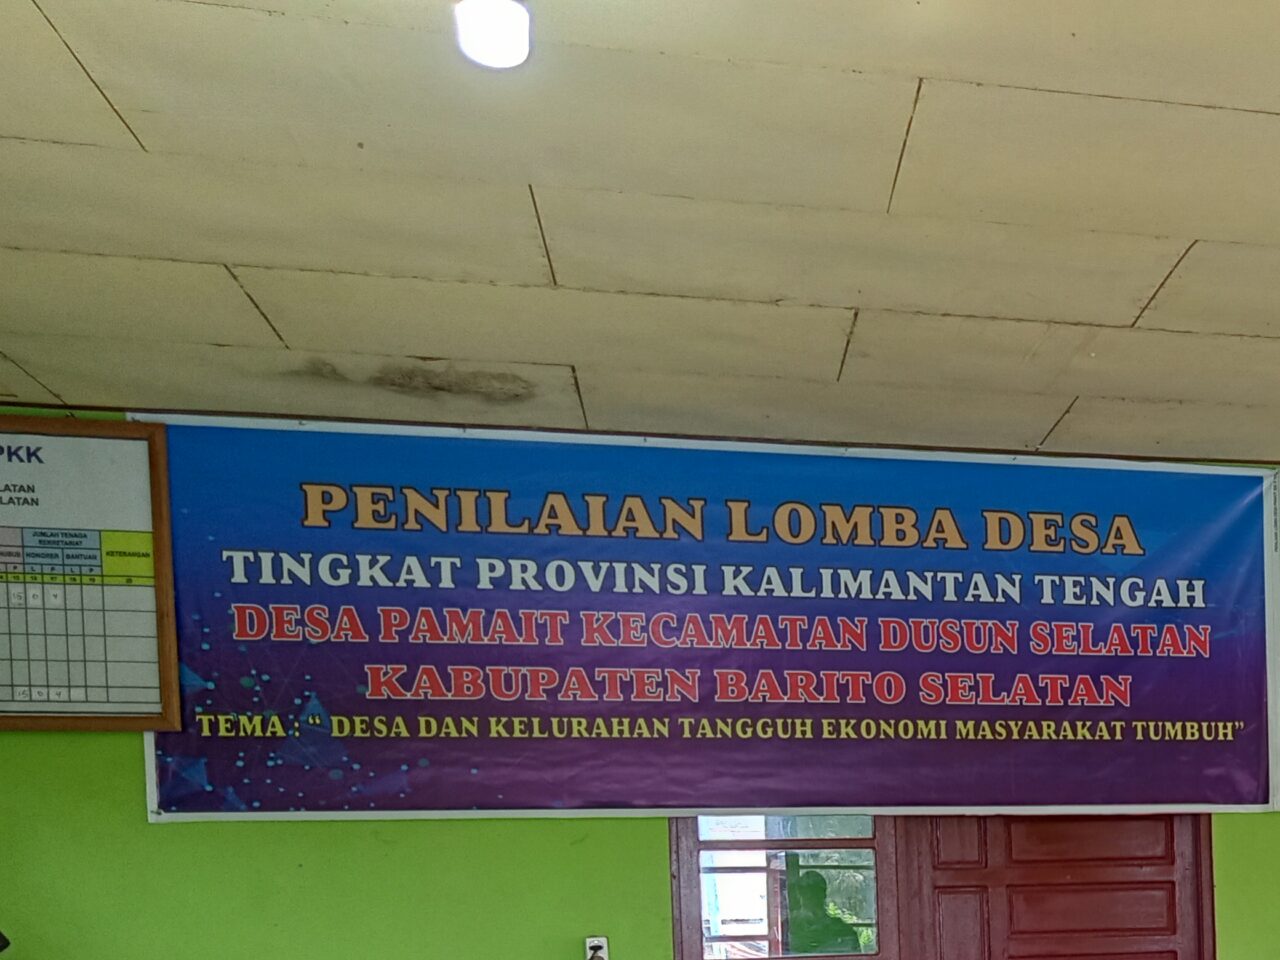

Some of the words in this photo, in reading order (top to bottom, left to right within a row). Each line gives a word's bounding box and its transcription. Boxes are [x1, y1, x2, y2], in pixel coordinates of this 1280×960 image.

[301, 483, 706, 540] PENILAIAN
[727, 499, 968, 550] LOMBA
[982, 508, 1145, 556] DESA
[222, 550, 463, 590] TINGKAT
[475, 557, 707, 597] PROVINSI
[722, 564, 1022, 604] KALIMANTAN
[1035, 575, 1206, 609] TENGAH
[232, 603, 369, 642] DESA
[378, 606, 569, 646] PAMAIT
[580, 611, 868, 651] KECAMATAN
[879, 618, 1018, 655] DUSUN
[1029, 621, 1211, 658] SELATAN
[365, 664, 700, 702] KABUPATEN
[714, 669, 906, 705] BARITO
[919, 672, 1132, 707] SELATAN
[196, 714, 286, 737] TEMA
[330, 716, 410, 738] DESA
[417, 716, 479, 738] DAN
[488, 716, 670, 740] KELURAHAN
[677, 717, 814, 741] TANGGUH
[821, 718, 949, 741] EKONOMI
[955, 719, 1125, 742] MASYARAKAT
